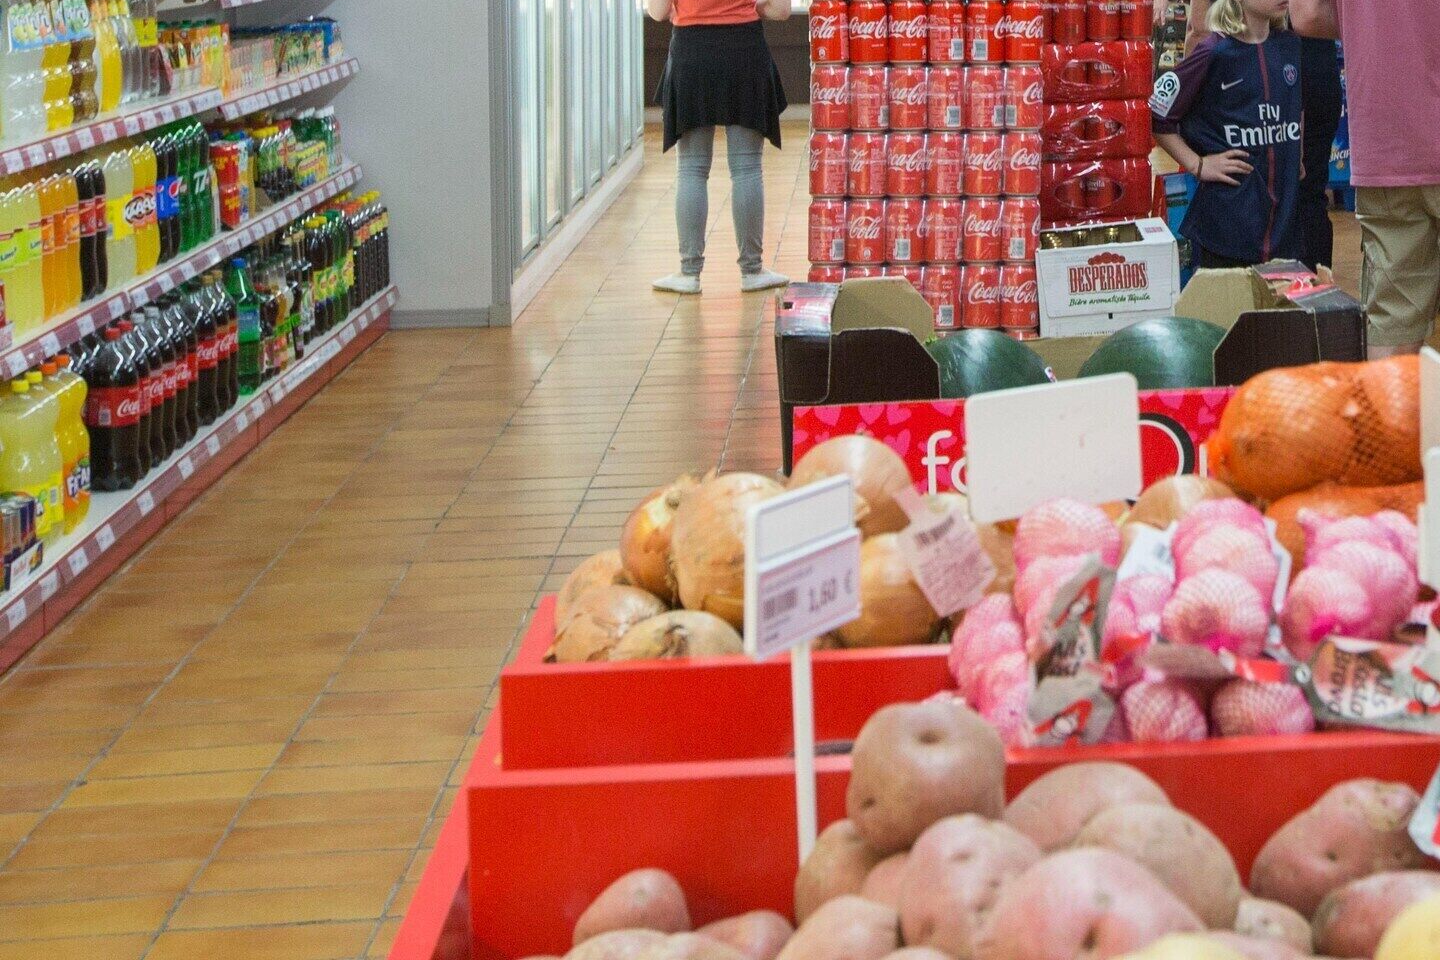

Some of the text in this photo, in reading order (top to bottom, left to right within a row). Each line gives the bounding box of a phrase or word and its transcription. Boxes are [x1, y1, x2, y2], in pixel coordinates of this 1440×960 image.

[1258, 103, 1280, 122] Fly
[1224, 121, 1300, 147] Emirate
[1069, 263, 1148, 293] DESPERADOS
